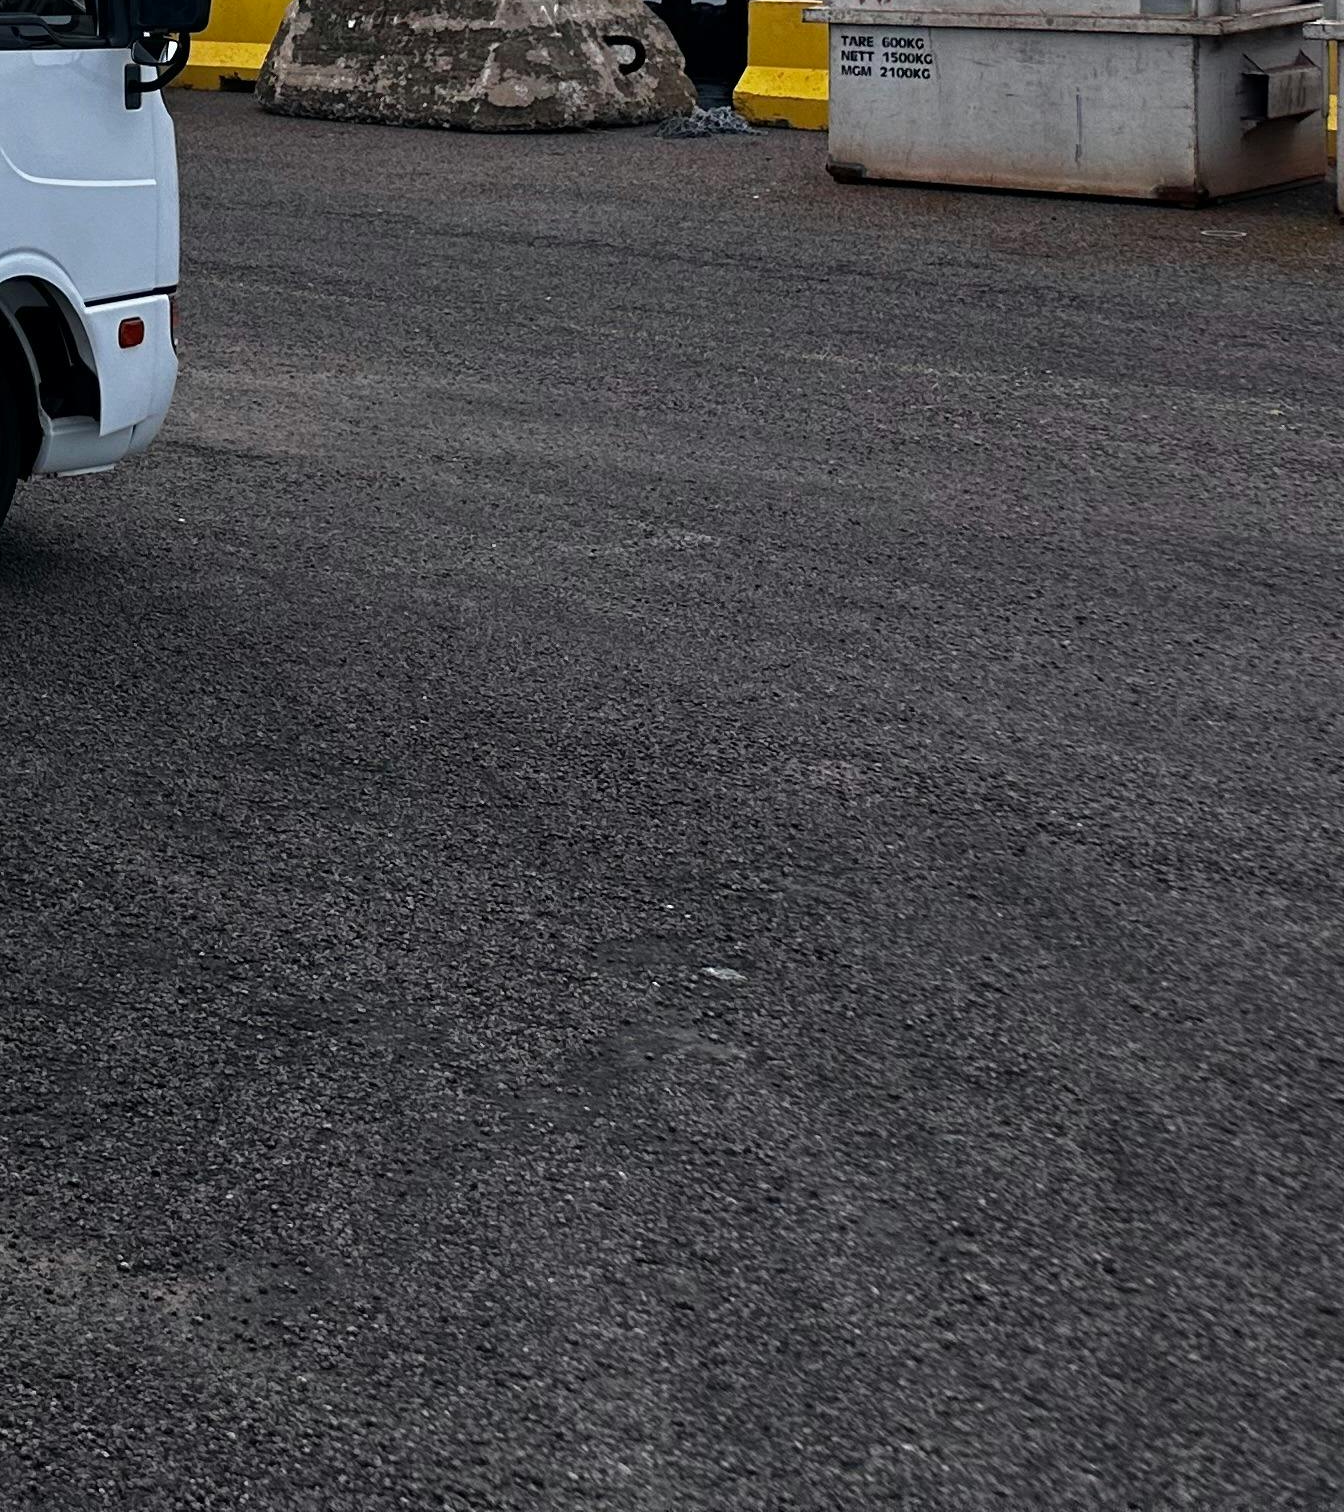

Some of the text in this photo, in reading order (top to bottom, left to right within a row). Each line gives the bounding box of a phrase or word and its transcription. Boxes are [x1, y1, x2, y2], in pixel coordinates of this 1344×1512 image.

[841, 35, 925, 50] TARE 600KG
[841, 50, 933, 65] NETT 1500KG
[841, 65, 931, 80] MGM 2100KG
